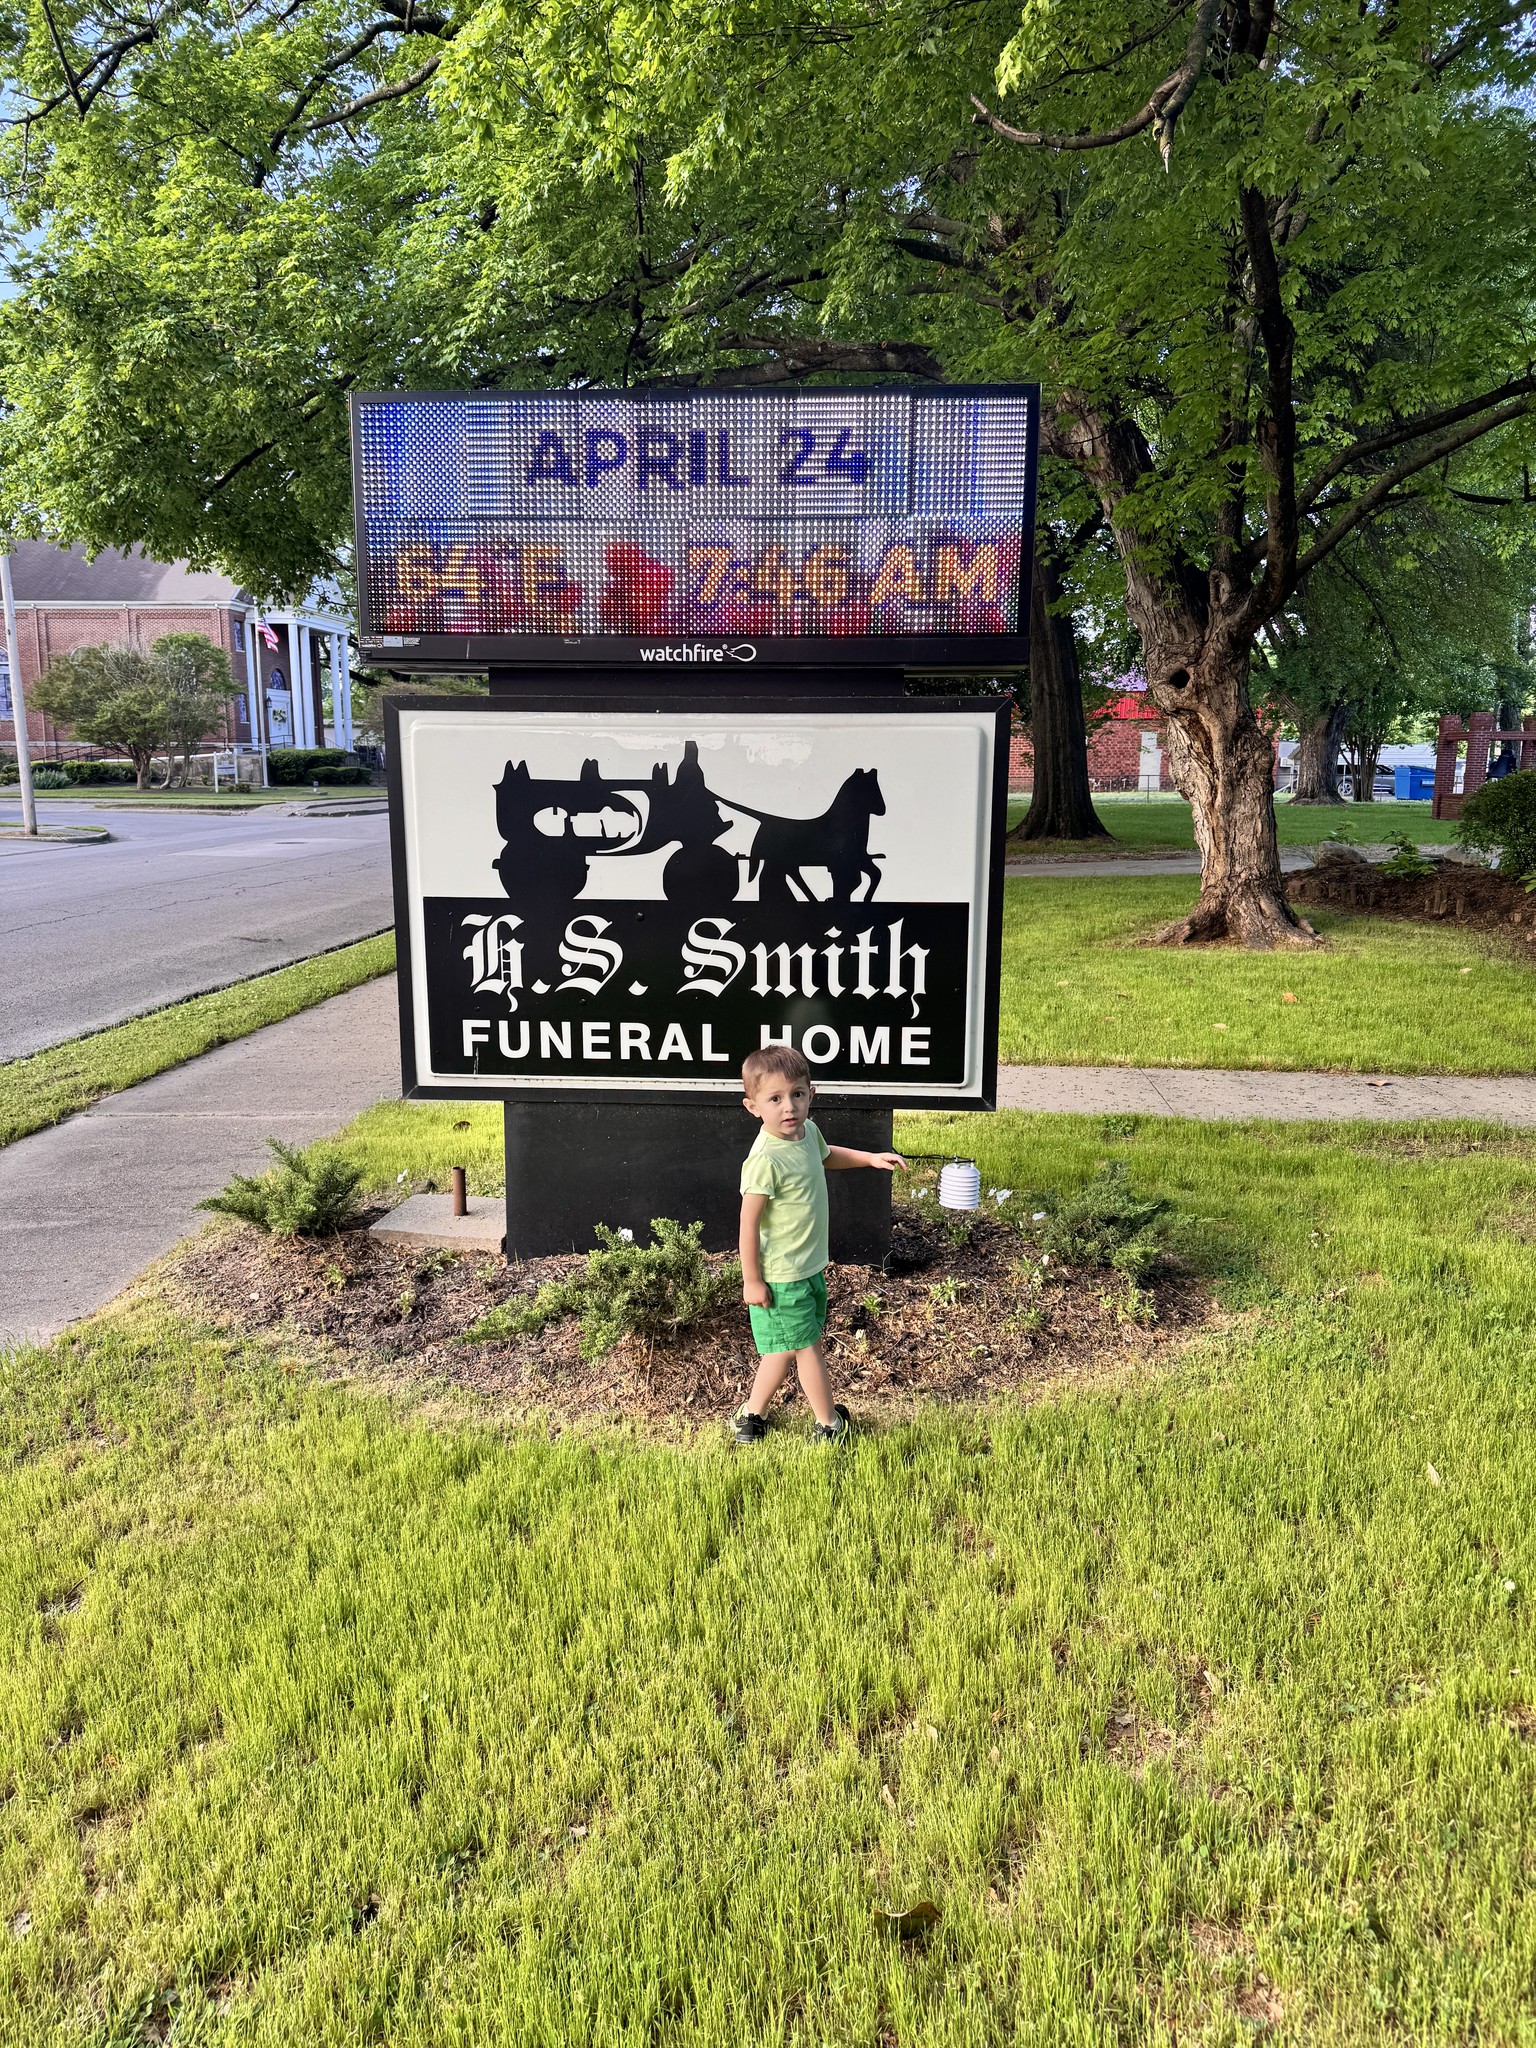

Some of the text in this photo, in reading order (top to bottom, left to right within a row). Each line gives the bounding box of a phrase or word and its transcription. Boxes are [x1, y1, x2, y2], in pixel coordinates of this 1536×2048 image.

[526, 428, 872, 489] APRIL 24
[688, 544, 850, 605] 7:46
[870, 542, 1000, 604] AM
[640, 643, 724, 662] watchfire
[676, 916, 931, 1020] Smith
[462, 1019, 932, 1065] FUNERAL HOME
